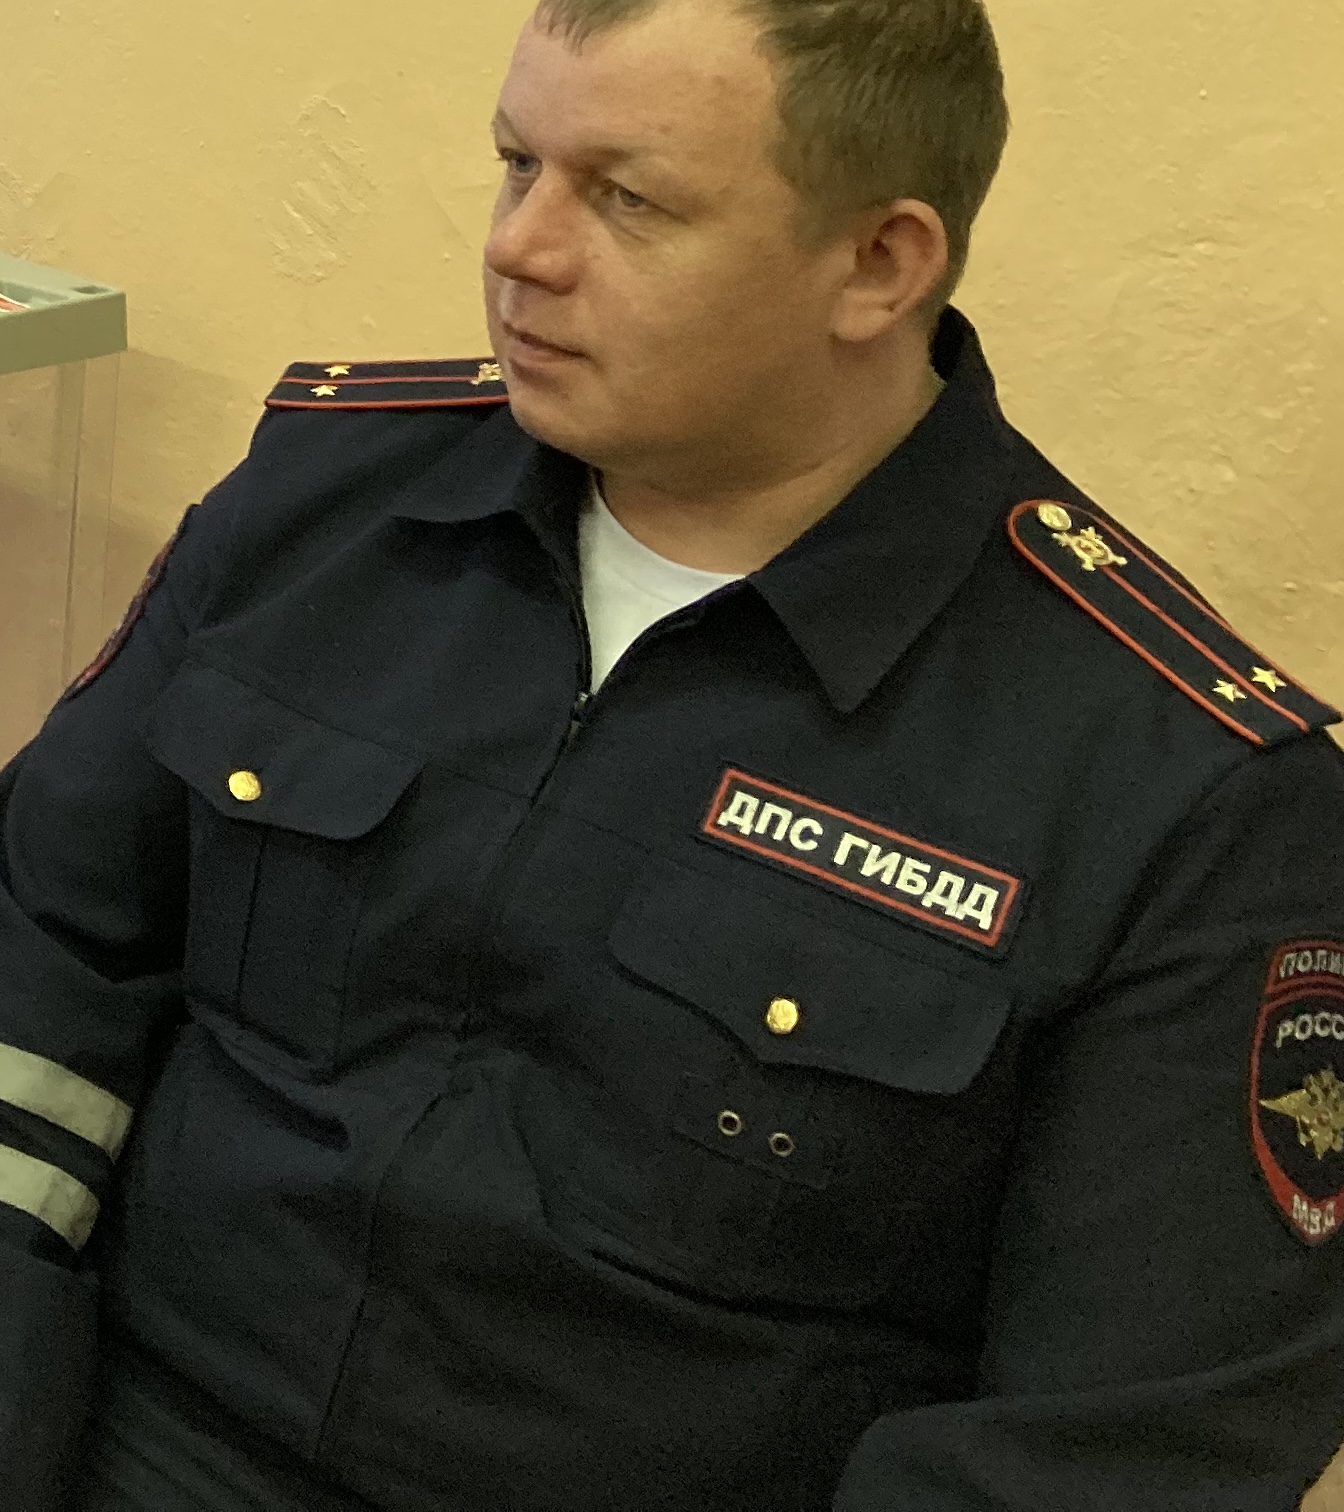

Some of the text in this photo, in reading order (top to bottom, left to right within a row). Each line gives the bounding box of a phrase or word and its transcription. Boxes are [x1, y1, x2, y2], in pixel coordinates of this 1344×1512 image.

[717, 790, 1000, 930] ДПС ГИБДД
[1279, 949, 1344, 979] ПОЛИ
[1275, 1011, 1344, 1049] РОСС
[1292, 1193, 1336, 1235] МВД
